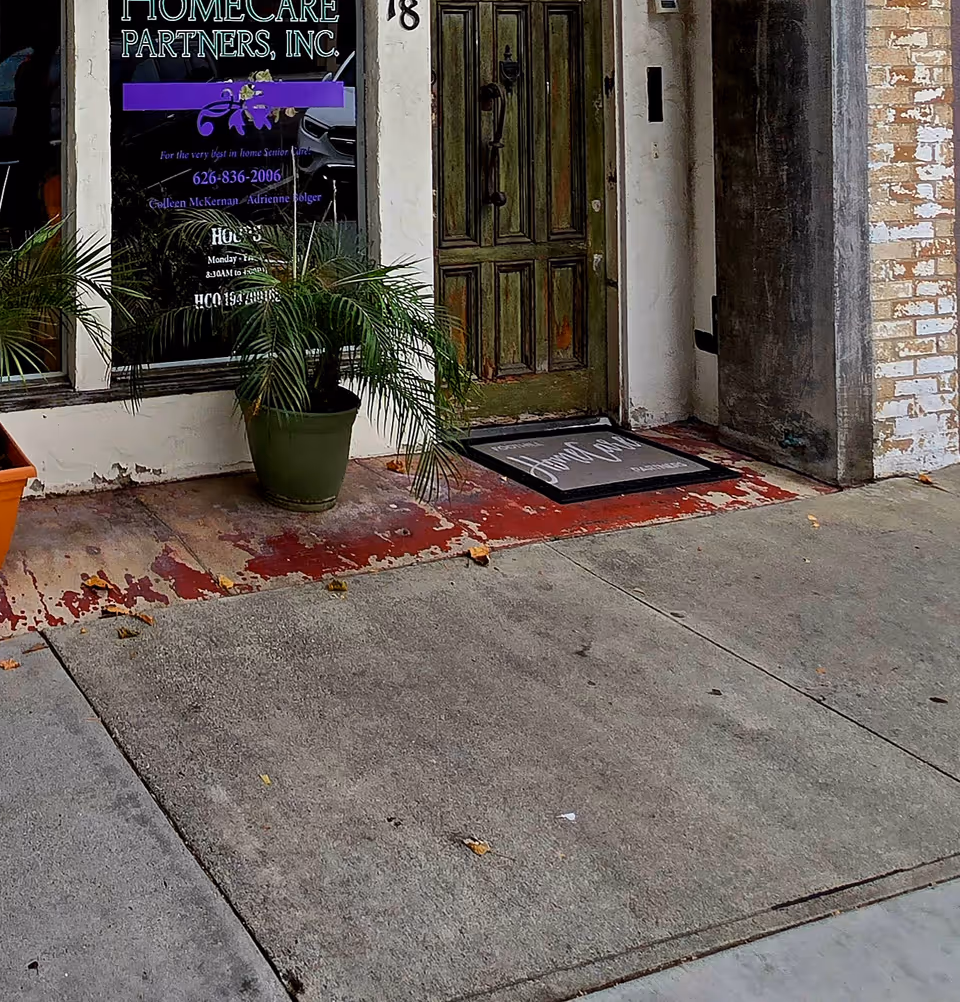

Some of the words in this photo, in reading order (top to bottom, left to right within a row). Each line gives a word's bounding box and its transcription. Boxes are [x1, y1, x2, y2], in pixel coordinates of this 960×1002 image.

[121, 28, 276, 61] PARTNERS,
[285, 29, 340, 60] INC.
[160, 150, 175, 160] For
[176, 150, 189, 159] the
[191, 150, 209, 160] very
[229, 149, 237, 158] in
[240, 148, 262, 158] home
[263, 147, 289, 157] Senior
[192, 168, 281, 185] 626-836-2006
[149, 197, 187, 209] Colleen
[189, 196, 239, 207] McKernan
[247, 194, 290, 205] Adrienne
[292, 192, 322, 205] Bolger
[207, 255, 237, 264] Monday
[194, 292, 222, 309] HCO
